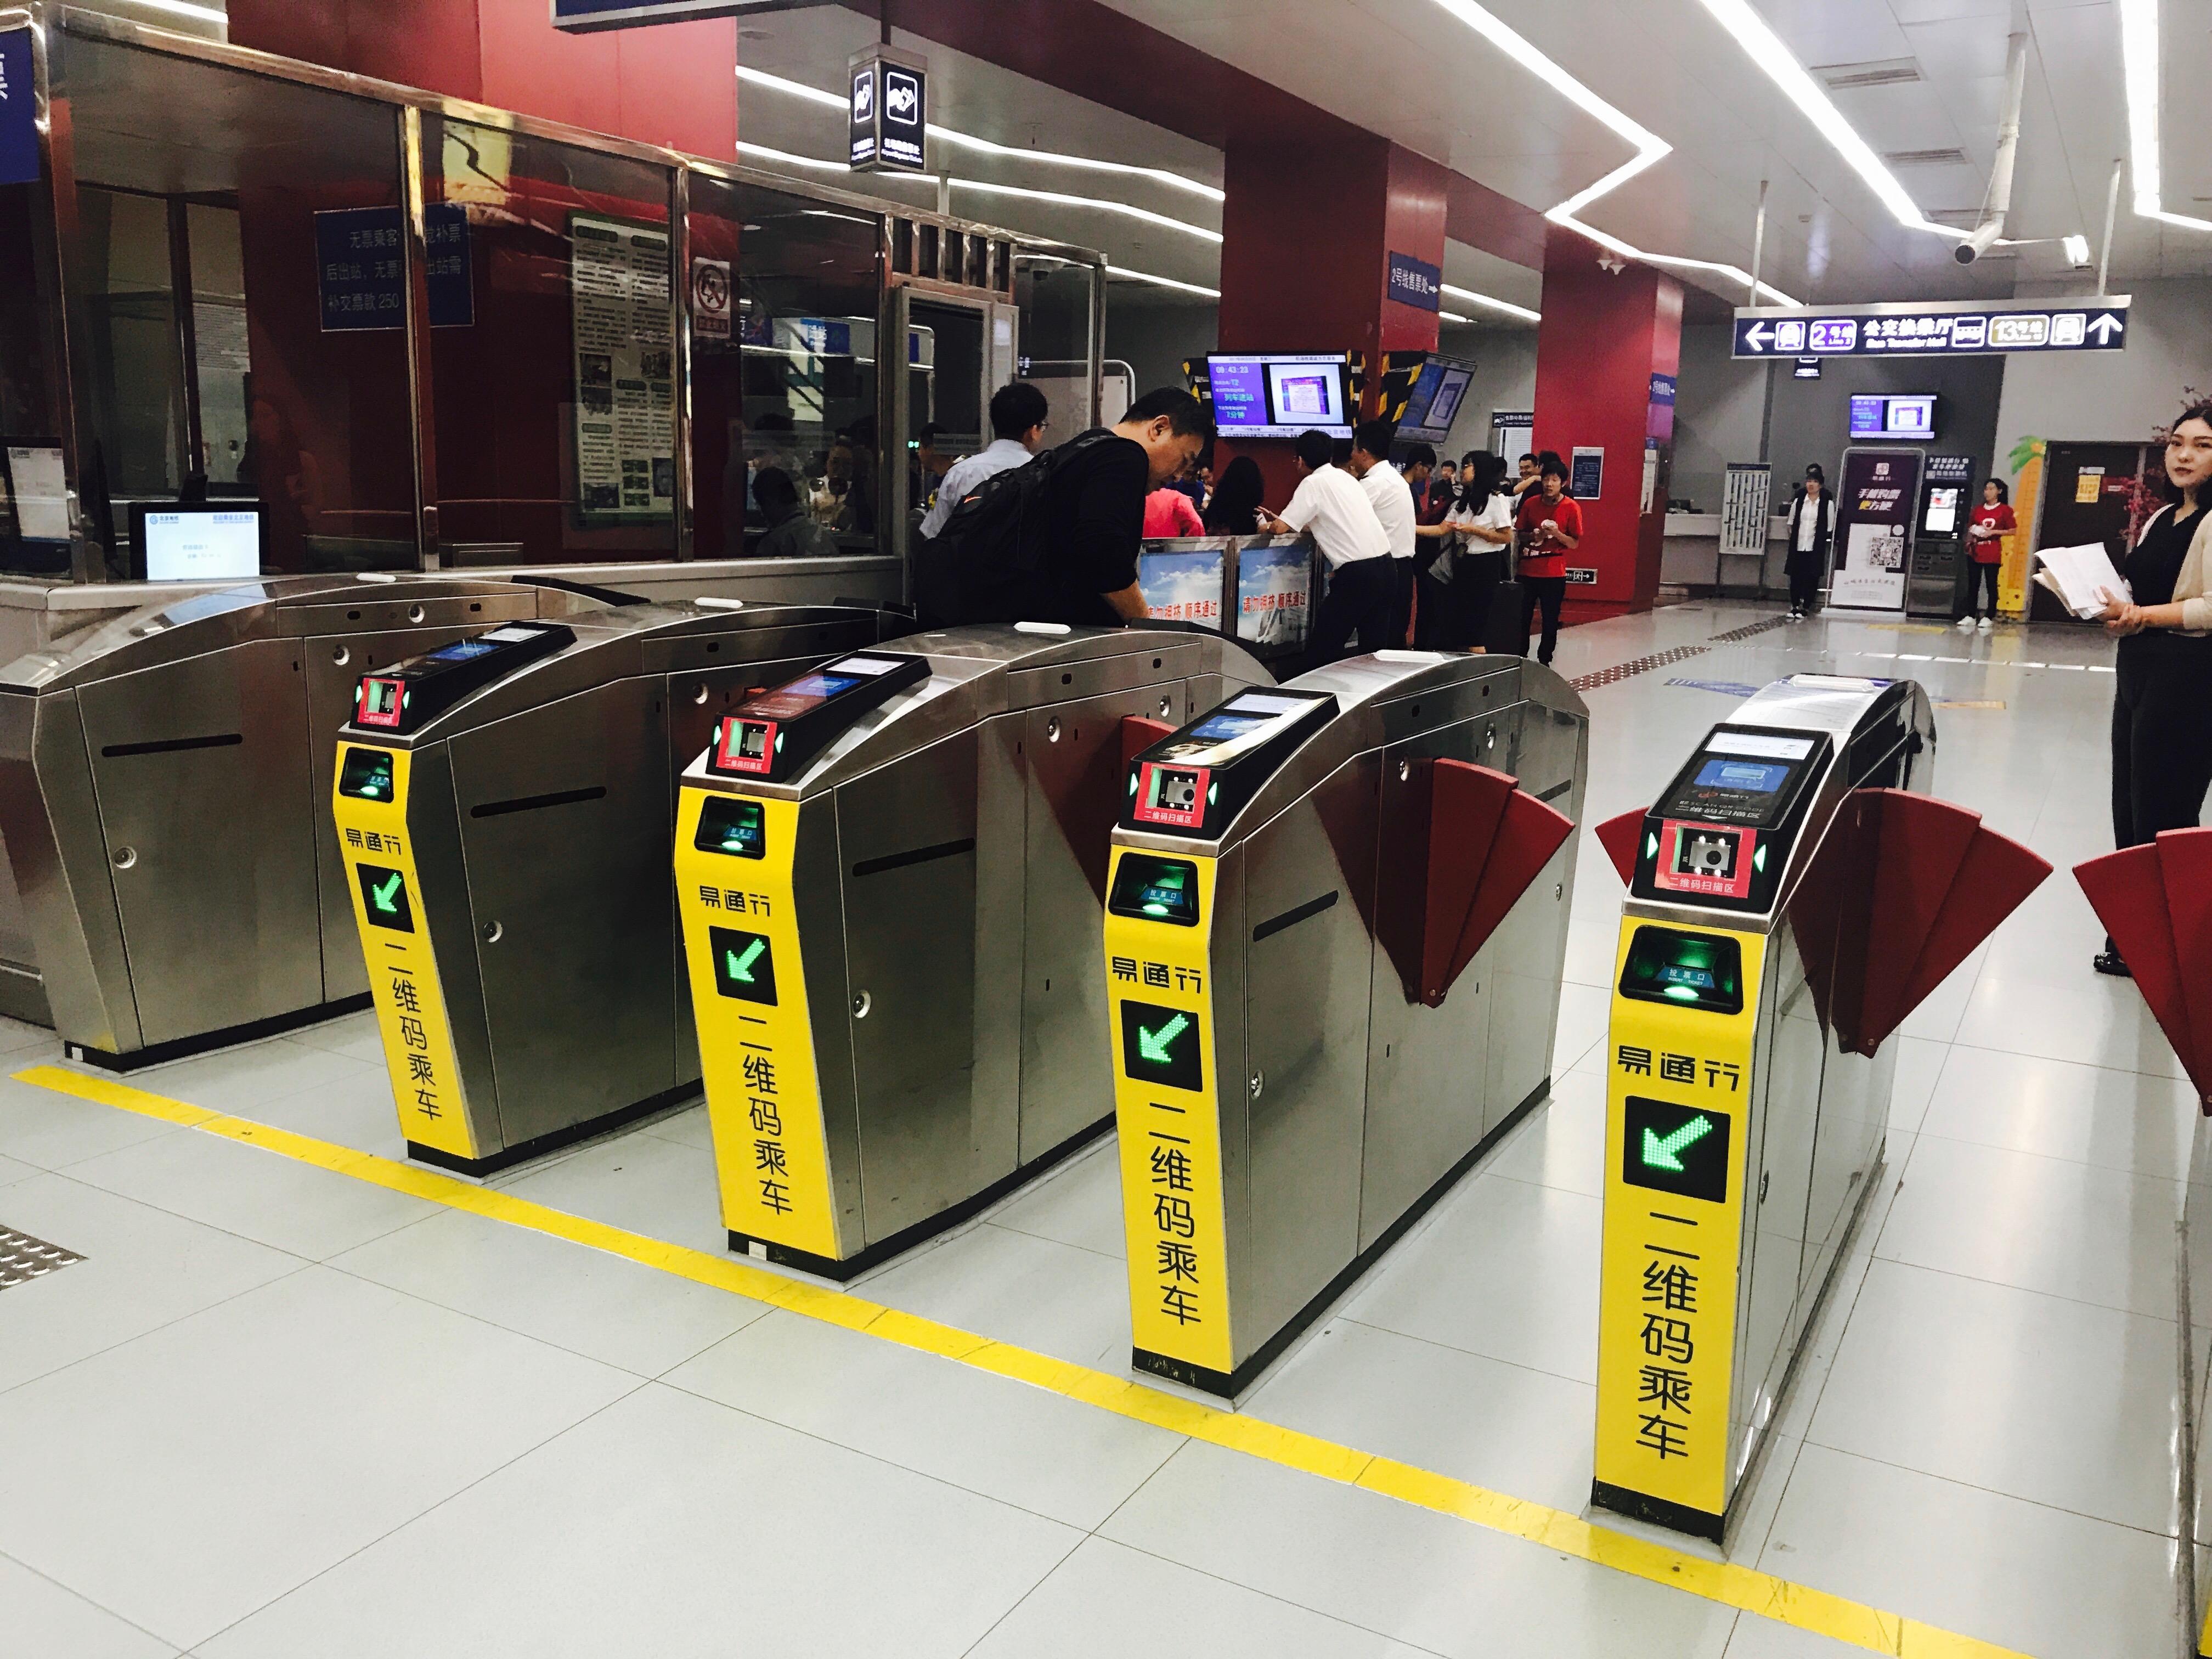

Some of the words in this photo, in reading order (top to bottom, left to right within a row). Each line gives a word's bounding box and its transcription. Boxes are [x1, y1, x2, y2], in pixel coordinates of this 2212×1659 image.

[1391, 268, 1428, 294] 2号线售票处
[1185, 600, 1217, 619] 顺序通过
[1243, 595, 1275, 613] 请勿拥挤
[1278, 591, 1306, 609] 顺序通过
[1144, 810, 1193, 824] 二维码扫描区
[1675, 805, 1762, 819] 二维码扫描区
[346, 828, 401, 855] 易通行
[1669, 877, 1734, 894] 二维码扫描区
[699, 885, 770, 917] 易通行
[1111, 956, 1201, 994] 易通行
[1669, 968, 1705, 981] 投票口
[385, 943, 442, 1120] 二维码乘车
[1617, 1044, 1740, 1092] 易通行
[738, 1015, 793, 1215] 二维码乘车
[1149, 1102, 1201, 1326] 二维码乘车
[1635, 1212, 1700, 1460] 二维码乘车
